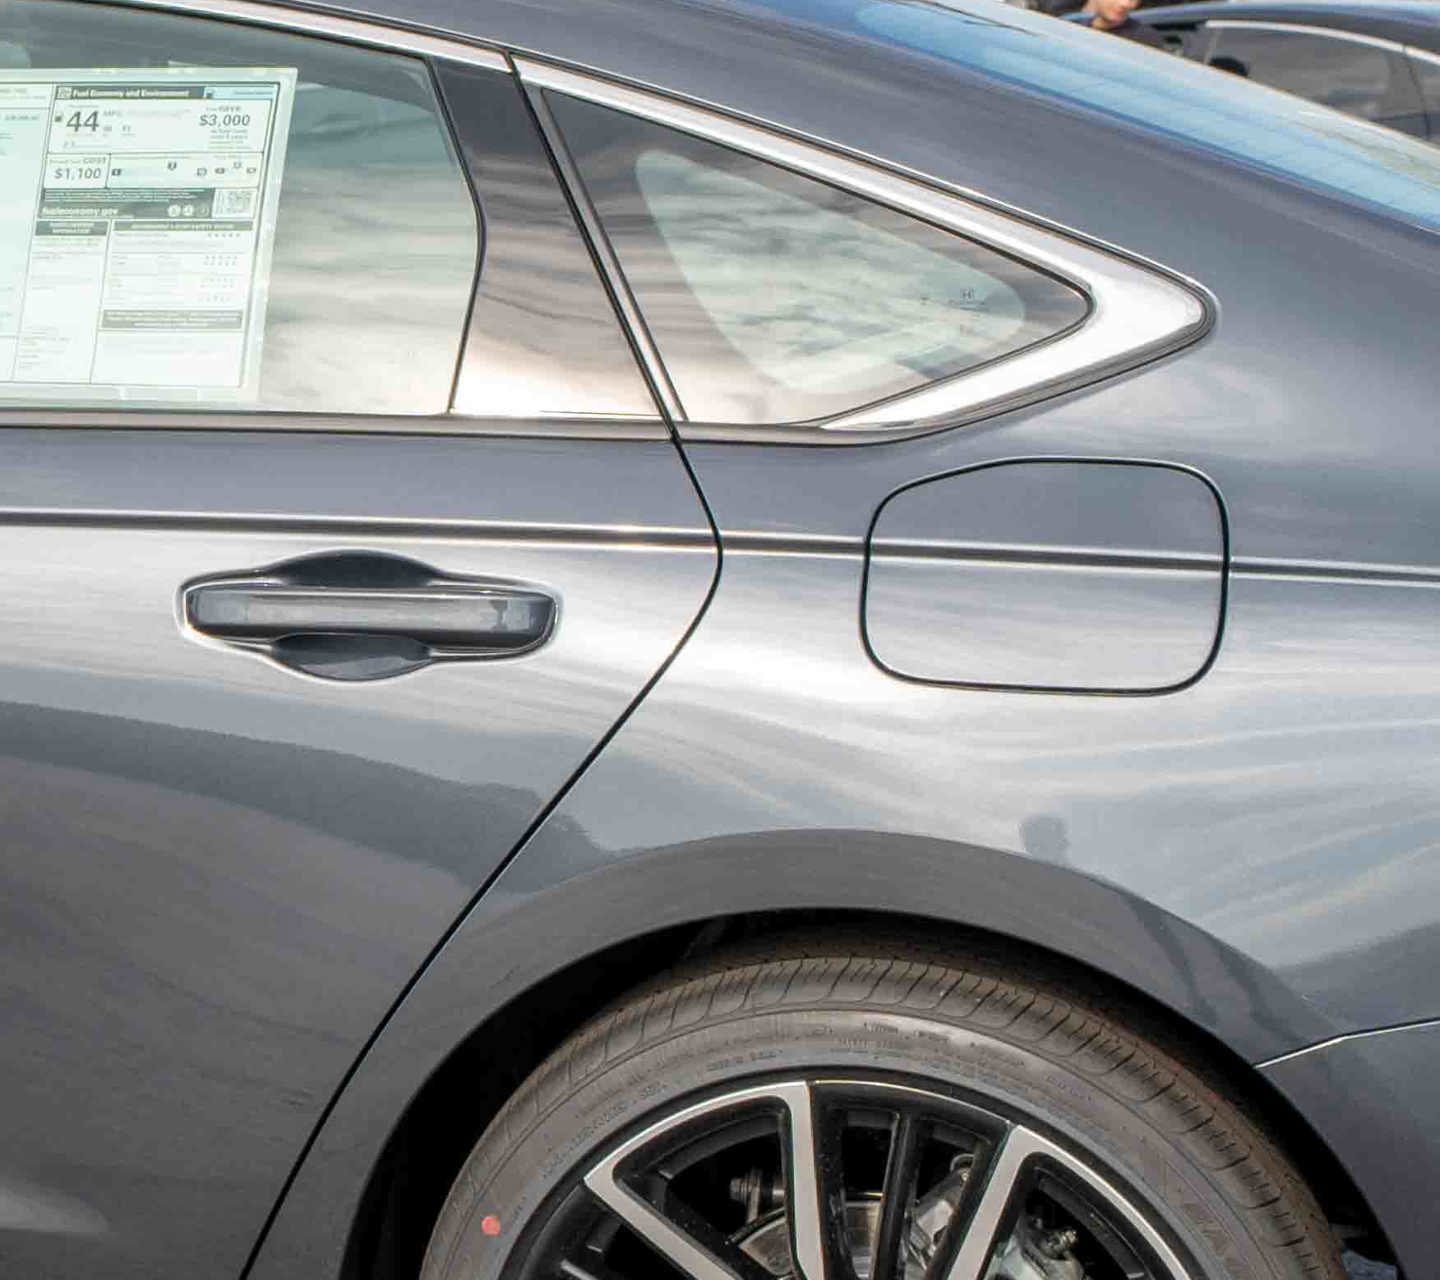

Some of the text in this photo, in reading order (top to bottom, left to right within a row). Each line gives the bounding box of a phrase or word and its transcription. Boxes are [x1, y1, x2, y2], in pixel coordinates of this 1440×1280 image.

[66, 111, 99, 132] 44
[199, 113, 250, 128] $3,000
[55, 167, 101, 181] $1,100
